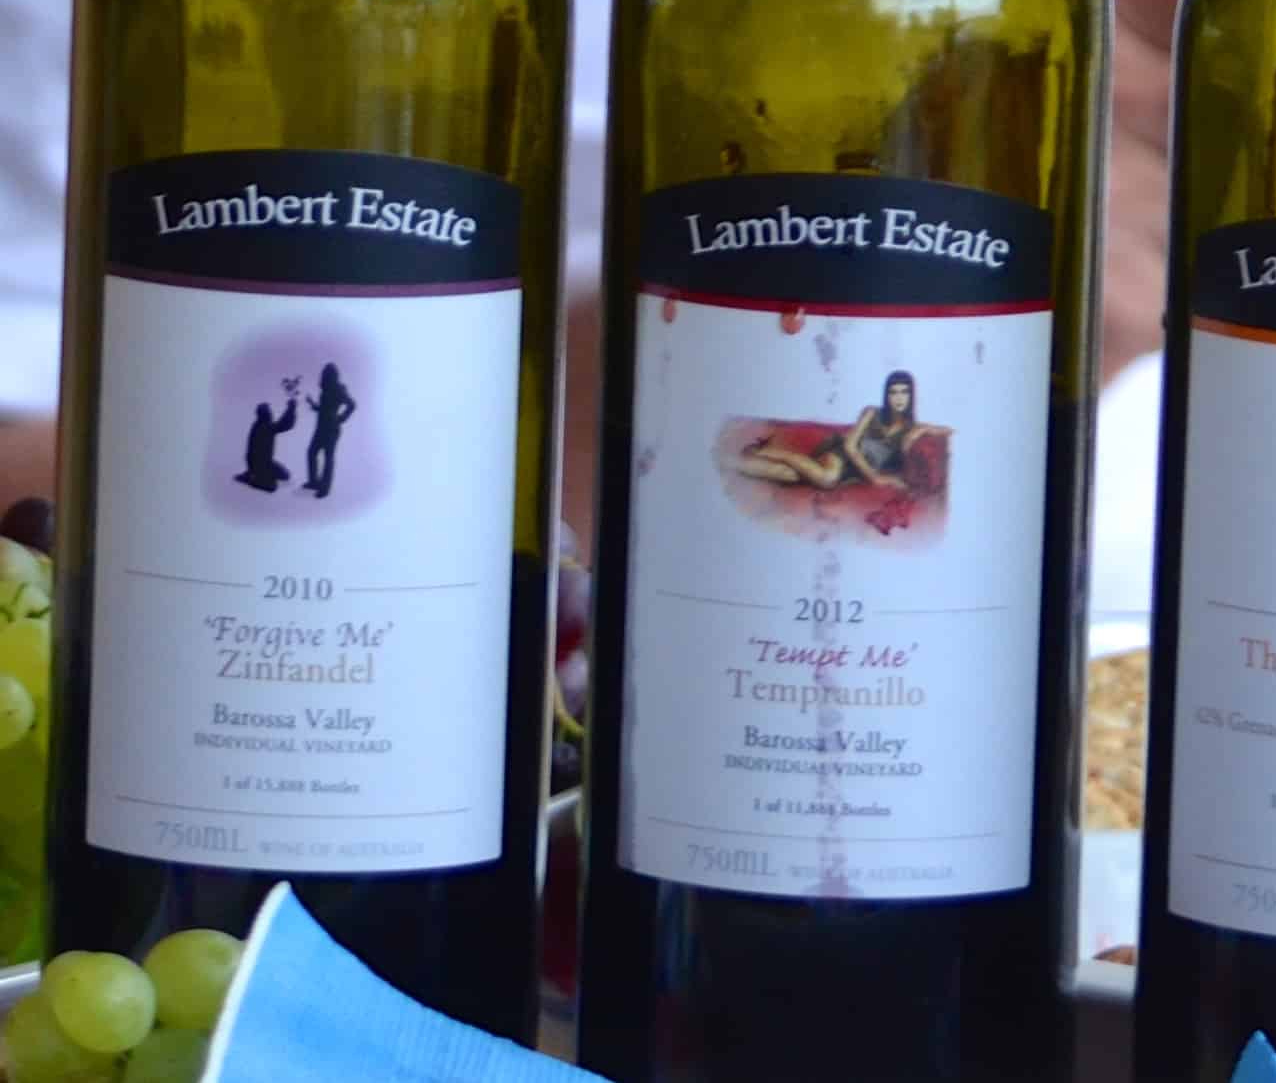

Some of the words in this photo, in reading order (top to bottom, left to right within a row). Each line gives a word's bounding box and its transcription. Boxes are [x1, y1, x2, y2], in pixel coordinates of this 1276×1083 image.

[152, 184, 340, 235] Lambert
[345, 186, 477, 248] Estate
[684, 205, 871, 254] Lambert
[877, 207, 1011, 268] Estate
[263, 576, 333, 601] 2010
[793, 598, 864, 624] 2012
[216, 649, 375, 684] Zinfandel
[726, 668, 926, 714] Tempranillo
[212, 702, 297, 729] Barossa
[304, 707, 376, 736] Valley
[193, 732, 298, 753] INDIVIDUAL
[304, 739, 393, 754] VINEYARD
[743, 725, 829, 753] Barossa
[834, 730, 908, 759] Valley
[832, 761, 924, 777] VINEYARD
